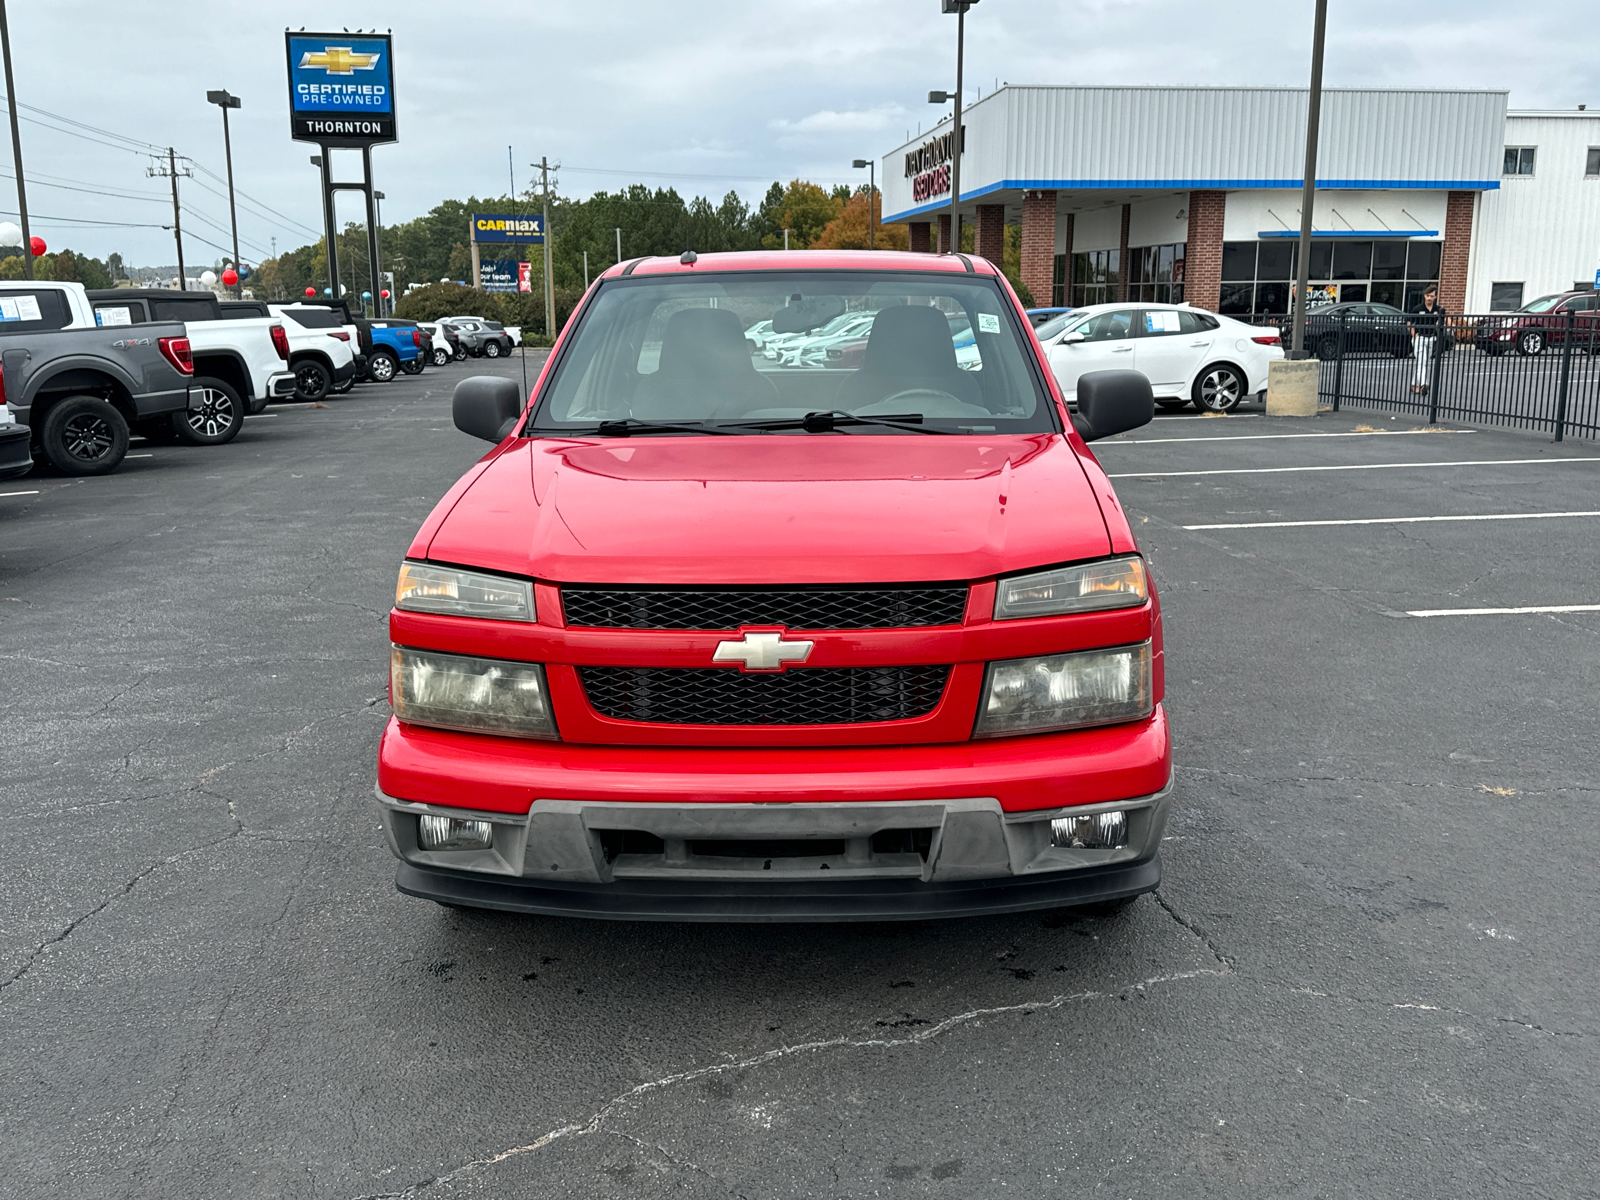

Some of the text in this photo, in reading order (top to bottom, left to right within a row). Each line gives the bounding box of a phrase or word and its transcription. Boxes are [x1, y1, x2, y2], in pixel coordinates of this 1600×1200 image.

[297, 84, 386, 95] CERTIFIED
[302, 94, 382, 105] PRE-OWNED
[306, 121, 381, 133] THORNTON
[913, 164, 951, 202] USED CARS
[480, 265, 494, 273] Join
[492, 273, 511, 281] team
